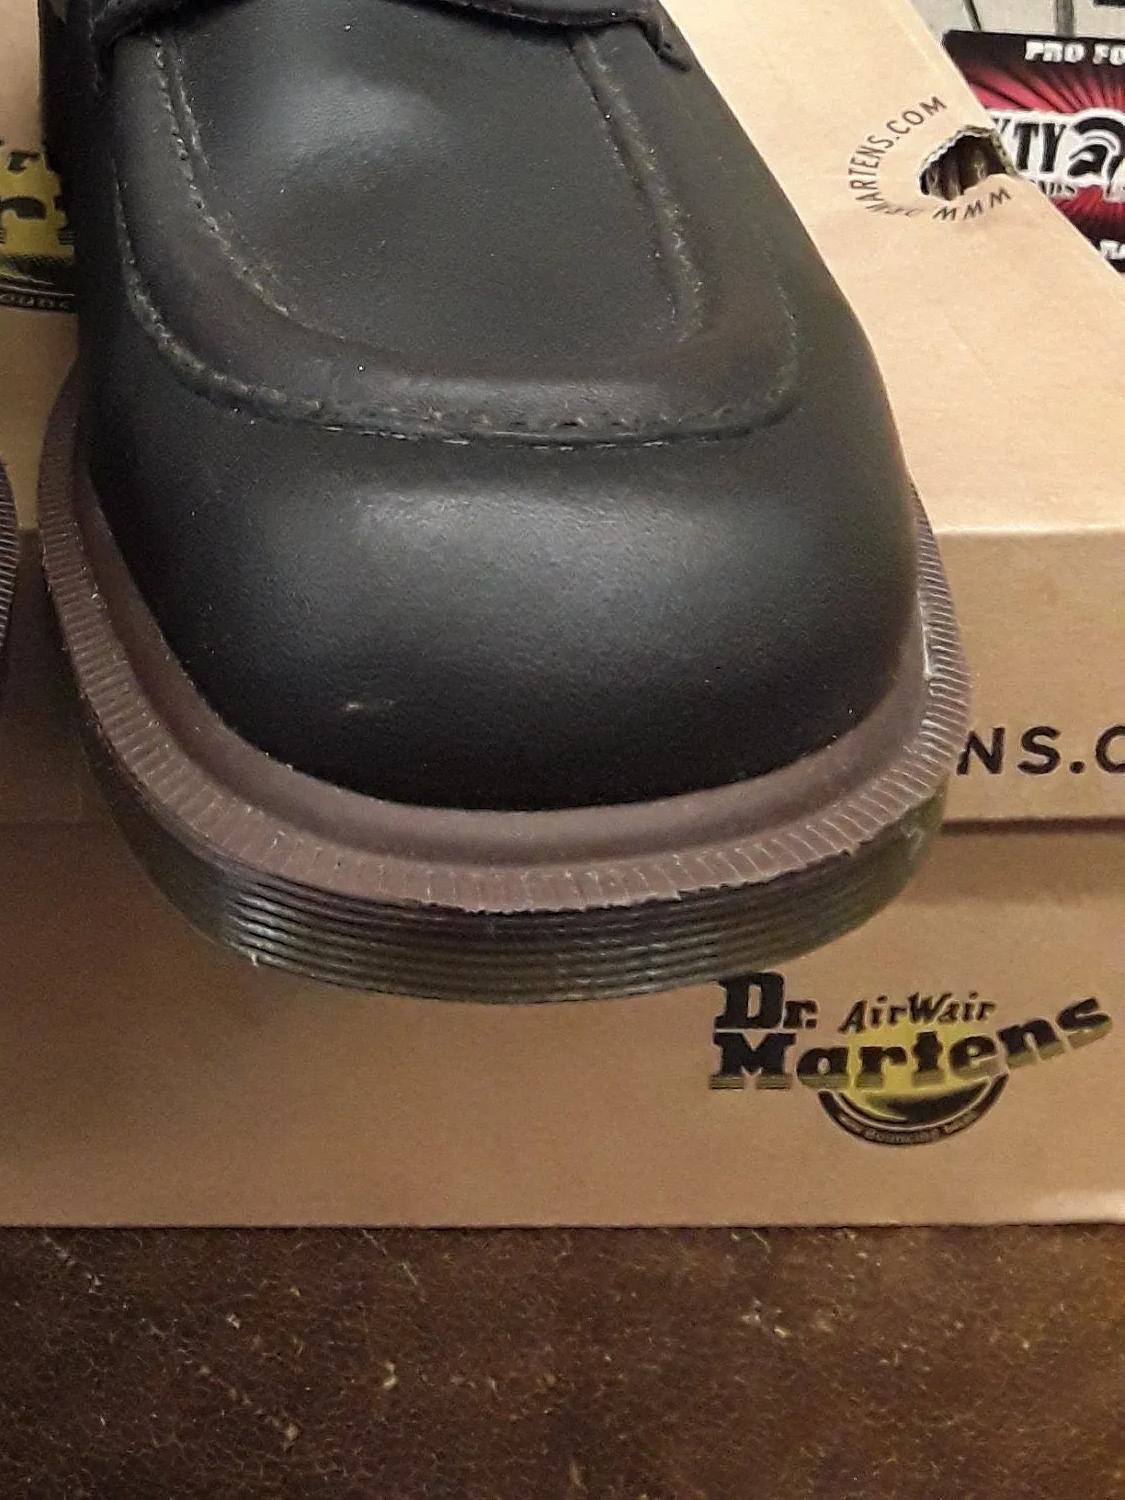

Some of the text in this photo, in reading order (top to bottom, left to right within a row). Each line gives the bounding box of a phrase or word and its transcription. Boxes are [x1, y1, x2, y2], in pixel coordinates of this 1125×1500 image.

[715, 970, 819, 1031] Dr.
[838, 990, 999, 1036] AirWair
[708, 996, 1114, 1091] Martens
